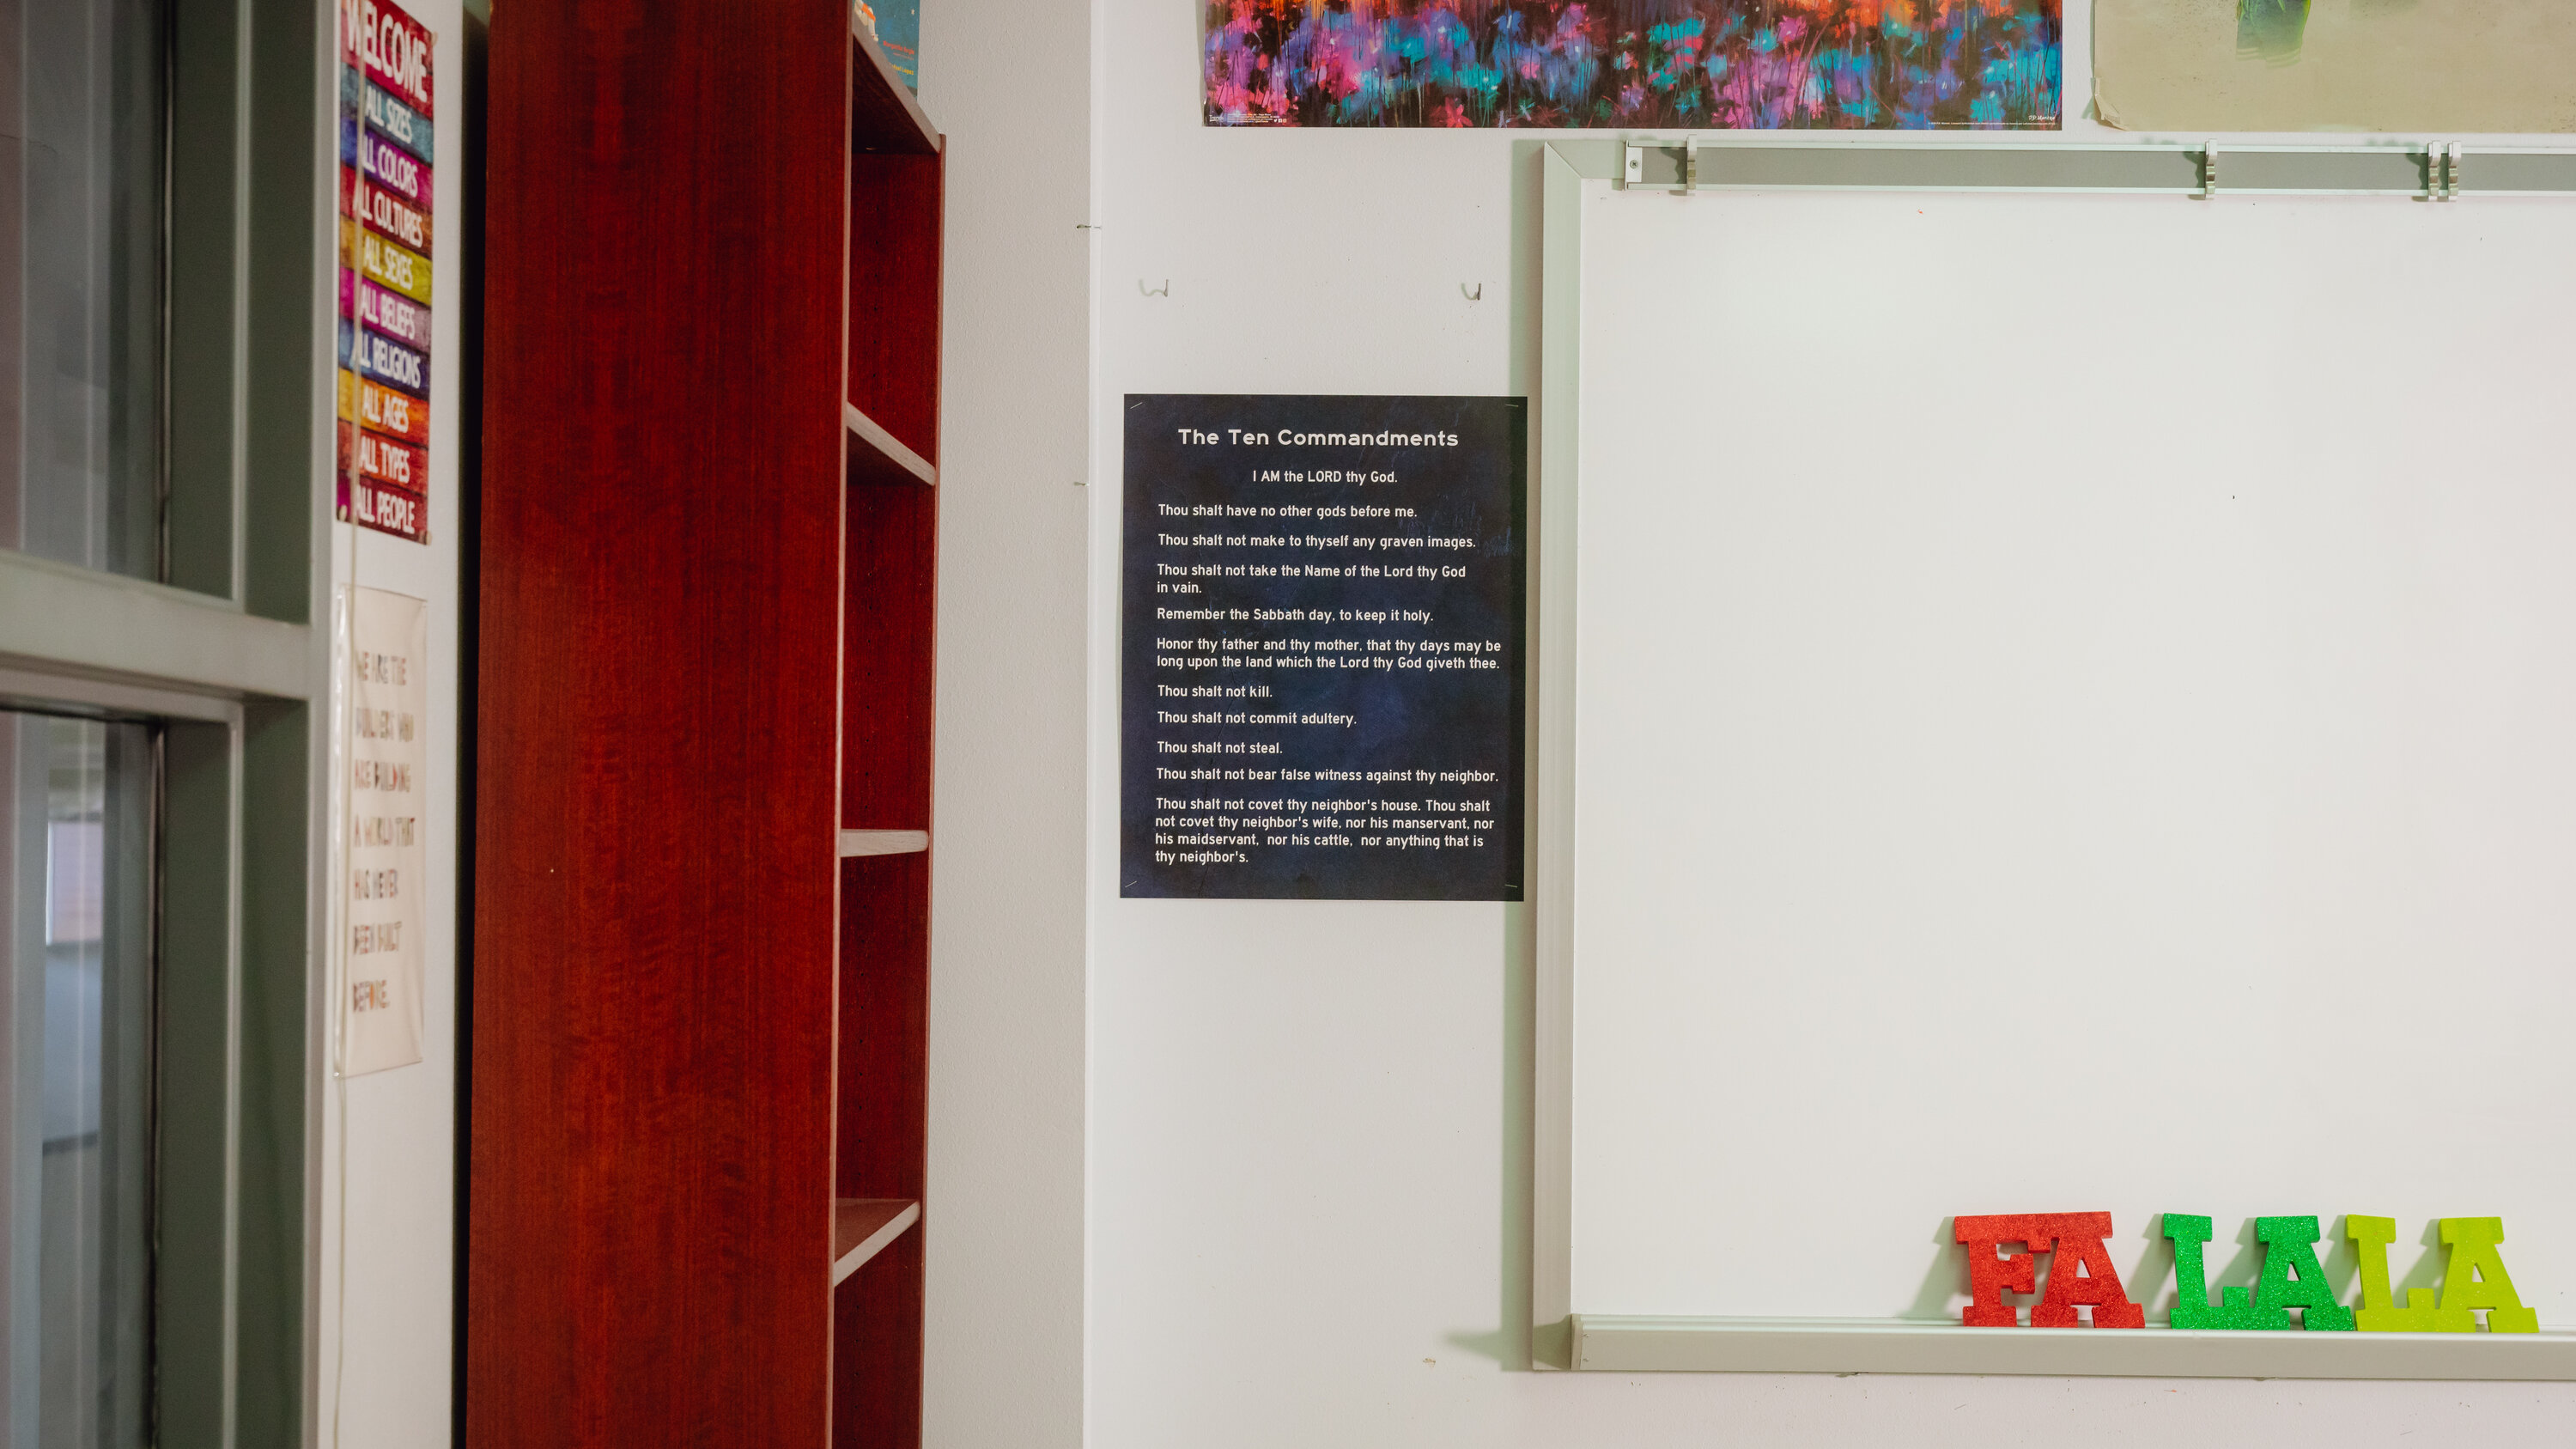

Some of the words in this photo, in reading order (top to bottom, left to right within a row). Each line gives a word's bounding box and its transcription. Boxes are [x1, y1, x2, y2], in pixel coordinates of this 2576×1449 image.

[346, 0, 428, 102] WELCOME
[364, 84, 385, 127] ALL
[386, 97, 412, 144] SIZES
[359, 135, 376, 174] LL
[378, 144, 418, 198] COLORS
[374, 191, 423, 248] CULTURES
[362, 234, 383, 276] ALL
[384, 245, 413, 290] SEXES
[359, 283, 379, 324] ALL
[380, 293, 416, 340] BELIEFS
[373, 337, 421, 389] RELIGIONS
[361, 384, 381, 423] ALL
[383, 393, 410, 434] AGES
[1177, 429, 1219, 445] The
[1227, 429, 1269, 446] Ten
[1277, 429, 1459, 447] Commandments
[359, 435, 379, 473] ALL
[380, 441, 410, 484] TYPES
[1253, 470, 1256, 482] I
[1261, 470, 1280, 482] AM
[1283, 470, 1304, 483] the
[1308, 470, 1342, 483] LORD
[1346, 471, 1367, 485] thy
[1370, 470, 1398, 483] God.
[354, 484, 375, 523] ALL
[377, 490, 416, 534] PEOPLE
[1157, 503, 1188, 516] Thou
[1192, 503, 1224, 516] shalt
[1226, 504, 1257, 517] have
[1261, 507, 1276, 517] no
[1279, 504, 1313, 517] other
[1316, 504, 1346, 518] gods
[1350, 504, 1391, 517] before
[1394, 508, 1418, 518] me.
[1157, 533, 1188, 546] Thou
[1192, 533, 1223, 546] shalt
[1226, 534, 1247, 546] not
[1250, 534, 1285, 547] make
[1289, 534, 1302, 547] to
[1305, 534, 1349, 551] thyself
[1352, 537, 1376, 551] any
[1379, 538, 1424, 551] graven
[1427, 535, 1476, 551] images.
[1157, 563, 1188, 576] Thou
[1191, 563, 1222, 576] shalt
[1225, 564, 1246, 576] not
[1249, 564, 1278, 576] take
[1280, 564, 1301, 576] the
[1304, 564, 1340, 577] Name
[1344, 564, 1357, 577] of
[1359, 564, 1381, 577] the
[1384, 564, 1413, 577] Lord
[1417, 565, 1438, 581] thy
[1442, 565, 1466, 578] God
[1157, 583, 1169, 594] in
[1171, 583, 1202, 594] vain.
[1157, 607, 1226, 620] Remember
[1229, 608, 1249, 620] the
[1253, 608, 1305, 621] Sabbath
[1309, 608, 1335, 624] day,
[1339, 609, 1352, 621] to
[1355, 609, 1387, 624] keep
[1390, 609, 1400, 622] it
[1403, 609, 1434, 625] holy.
[1157, 637, 1194, 650] Honor
[1197, 637, 1218, 654] thy
[1221, 637, 1260, 650] father
[1263, 638, 1286, 650] and
[1290, 638, 1311, 654] thy
[1315, 638, 1363, 652] mother,
[1366, 639, 1392, 651] that
[1394, 639, 1416, 655] thy
[1419, 639, 1450, 655] days
[1454, 642, 1482, 655] may
[1485, 639, 1502, 652] be
[1157, 654, 1183, 671] long
[1187, 657, 1218, 671] upon
[1221, 655, 1242, 667] the
[1245, 655, 1273, 667] land
[1276, 655, 1313, 668] which
[1315, 655, 1336, 668] the
[1340, 655, 1370, 668] Lord
[1372, 656, 1394, 673] thy
[1397, 656, 1422, 669] God
[1425, 656, 1466, 673] giveth
[1468, 656, 1500, 669] thee.
[1157, 685, 1188, 697] Thou
[1192, 685, 1223, 697] shalt
[1225, 685, 1246, 697] not
[1249, 685, 1273, 697] kill.
[1157, 710, 1188, 723] Thou
[1191, 711, 1223, 724] shalt
[1225, 711, 1246, 724] not
[1249, 711, 1297, 724] commit
[1301, 712, 1357, 728] adultery.
[1157, 740, 1188, 753] Thou
[1191, 741, 1222, 754] shalt
[1225, 741, 1246, 754] not
[1249, 741, 1283, 754] steal.
[1156, 767, 1187, 780] Thou
[1190, 767, 1221, 780] shalt
[1224, 768, 1245, 780] not
[1249, 768, 1278, 781] bear
[1280, 768, 1311, 781] false
[1315, 768, 1363, 781] witness
[1365, 769, 1413, 785] against
[1415, 769, 1437, 785] thy
[1440, 769, 1498, 785] neighbor.
[1156, 797, 1187, 810] Thou
[1190, 797, 1221, 810] shalt
[1224, 798, 1245, 810] not
[1248, 798, 1284, 811] covet
[1286, 798, 1308, 814] thy
[1311, 798, 1378, 814] neighbor's
[1381, 799, 1421, 812] house.
[1425, 799, 1456, 812] Thou
[1460, 800, 1491, 812] shalt
[1155, 815, 1176, 827] not
[1179, 815, 1215, 828] covet
[1218, 815, 1239, 831] thy
[1242, 815, 1309, 831] neighbor's
[1312, 816, 1342, 830] wife,
[1346, 819, 1367, 829] nor
[1370, 816, 1388, 829] his
[1392, 817, 1470, 831] manservant,
[1473, 819, 1495, 830] nor
[1155, 832, 1174, 845] his
[1177, 832, 1260, 846] maidservant,
[1267, 836, 1288, 846] nor
[1291, 833, 1310, 846] his
[1314, 833, 1353, 847] cattle,
[1361, 837, 1382, 846] nor
[1385, 834, 1440, 850] anything
[1443, 834, 1469, 847] that
[1473, 834, 1484, 847] is
[1155, 849, 1176, 866] thy
[1179, 849, 1249, 866] neighbor's.
[1954, 1211, 2145, 1329] FA
[2163, 1213, 2354, 1331] LA
[2345, 1214, 2540, 1333] LA
